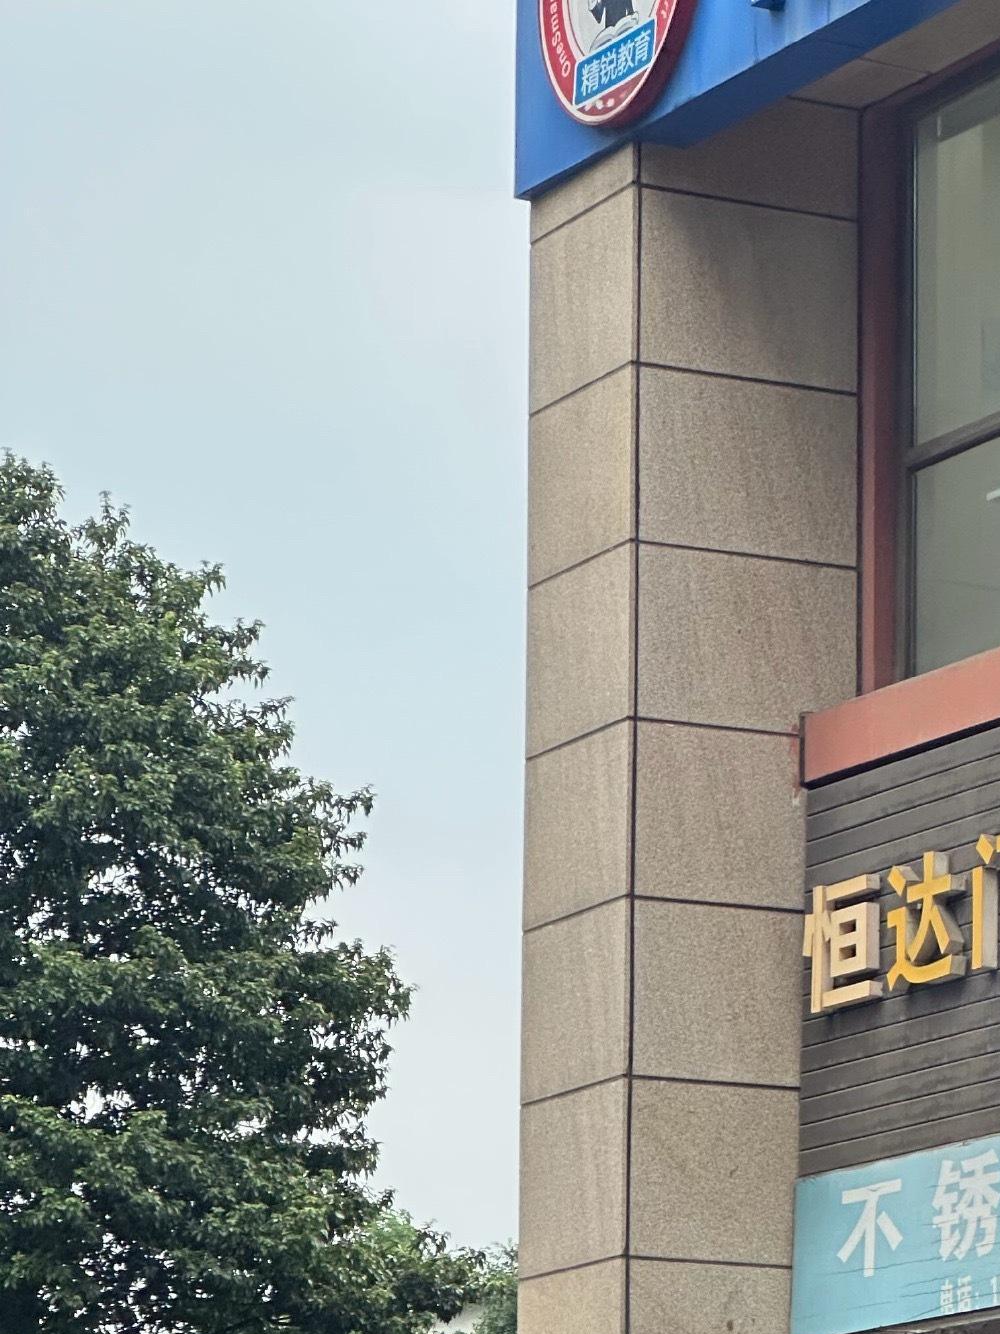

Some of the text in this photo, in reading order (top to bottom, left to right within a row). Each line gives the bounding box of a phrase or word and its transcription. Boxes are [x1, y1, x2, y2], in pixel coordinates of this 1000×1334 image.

[550, 0, 571, 77] OneSma
[581, 29, 651, 96] 精锐教育
